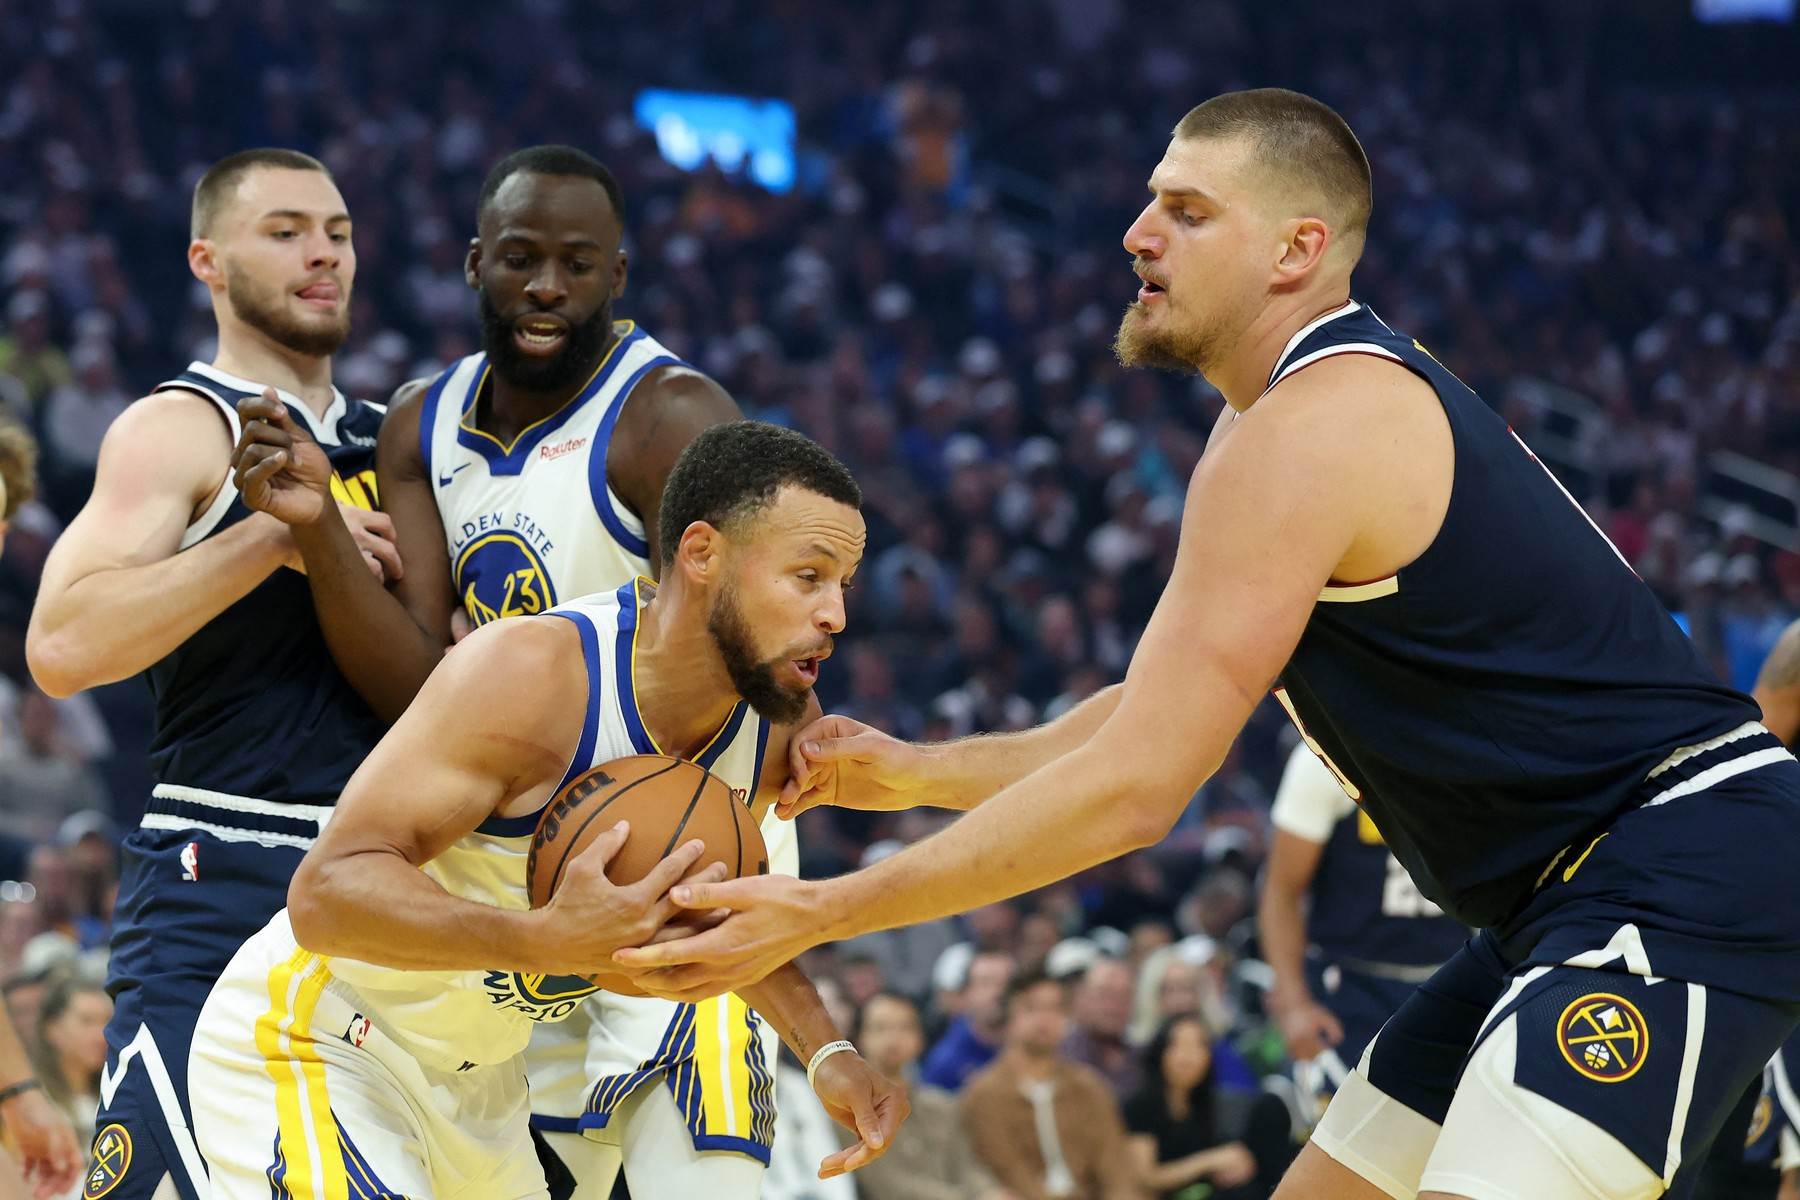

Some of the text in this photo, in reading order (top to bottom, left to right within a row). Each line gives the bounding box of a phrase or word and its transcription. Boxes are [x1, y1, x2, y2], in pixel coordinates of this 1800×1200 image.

[540, 438, 586, 460] Rakuten
[450, 512, 554, 557] LDEN STATE
[501, 568, 541, 617] 23
